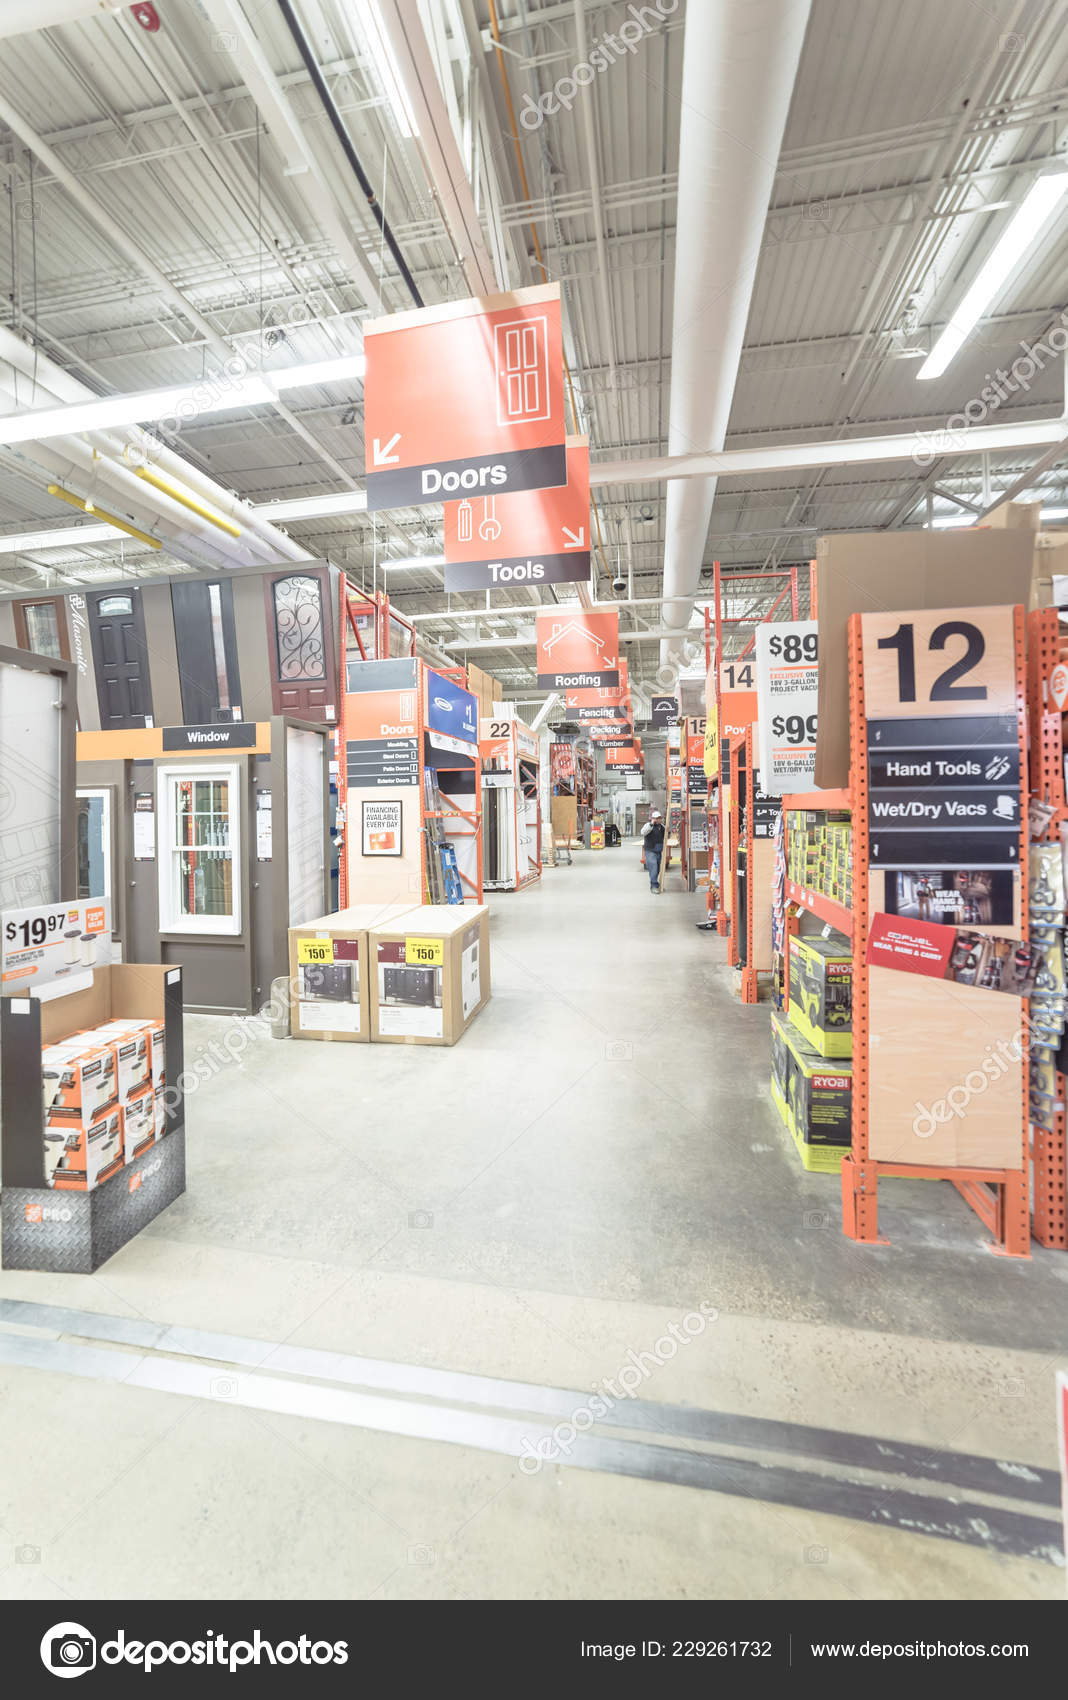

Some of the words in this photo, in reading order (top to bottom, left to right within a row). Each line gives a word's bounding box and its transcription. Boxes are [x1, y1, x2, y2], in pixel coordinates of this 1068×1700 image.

[421, 463, 508, 495] Doors
[487, 560, 545, 582] Tools
[877, 620, 988, 703] 12
[555, 674, 601, 687] Roofing
[723, 664, 754, 689] 14
[770, 672, 804, 680] EXCLUSIVE
[784, 678, 816, 687] 3-GALLON
[770, 685, 798, 693] PROJECT
[578, 707, 615, 718] Fencing
[380, 723, 415, 736] Doors
[490, 722, 511, 738] 22
[690, 719, 706, 734] 15
[187, 731, 230, 743] Window
[600, 739, 625, 747] Lumber
[773, 752, 807, 761] EXCLUSIVE
[670, 767, 679, 776] 17
[773, 766, 807, 774] WET/DRY
[886, 761, 932, 777] Hand
[935, 760, 981, 776] Tools
[366, 806, 399, 814] FINANCING
[872, 801, 942, 819] Wet/Dry
[944, 801, 987, 816] Vacs
[366, 813, 399, 821] AVAILABLE
[366, 820, 386, 828] EVERY
[386, 820, 399, 828] DAY
[935, 889, 962, 898] WEAR
[813, 1076, 849, 1089] RYOBI
[42, 1207, 73, 1222] PRO
